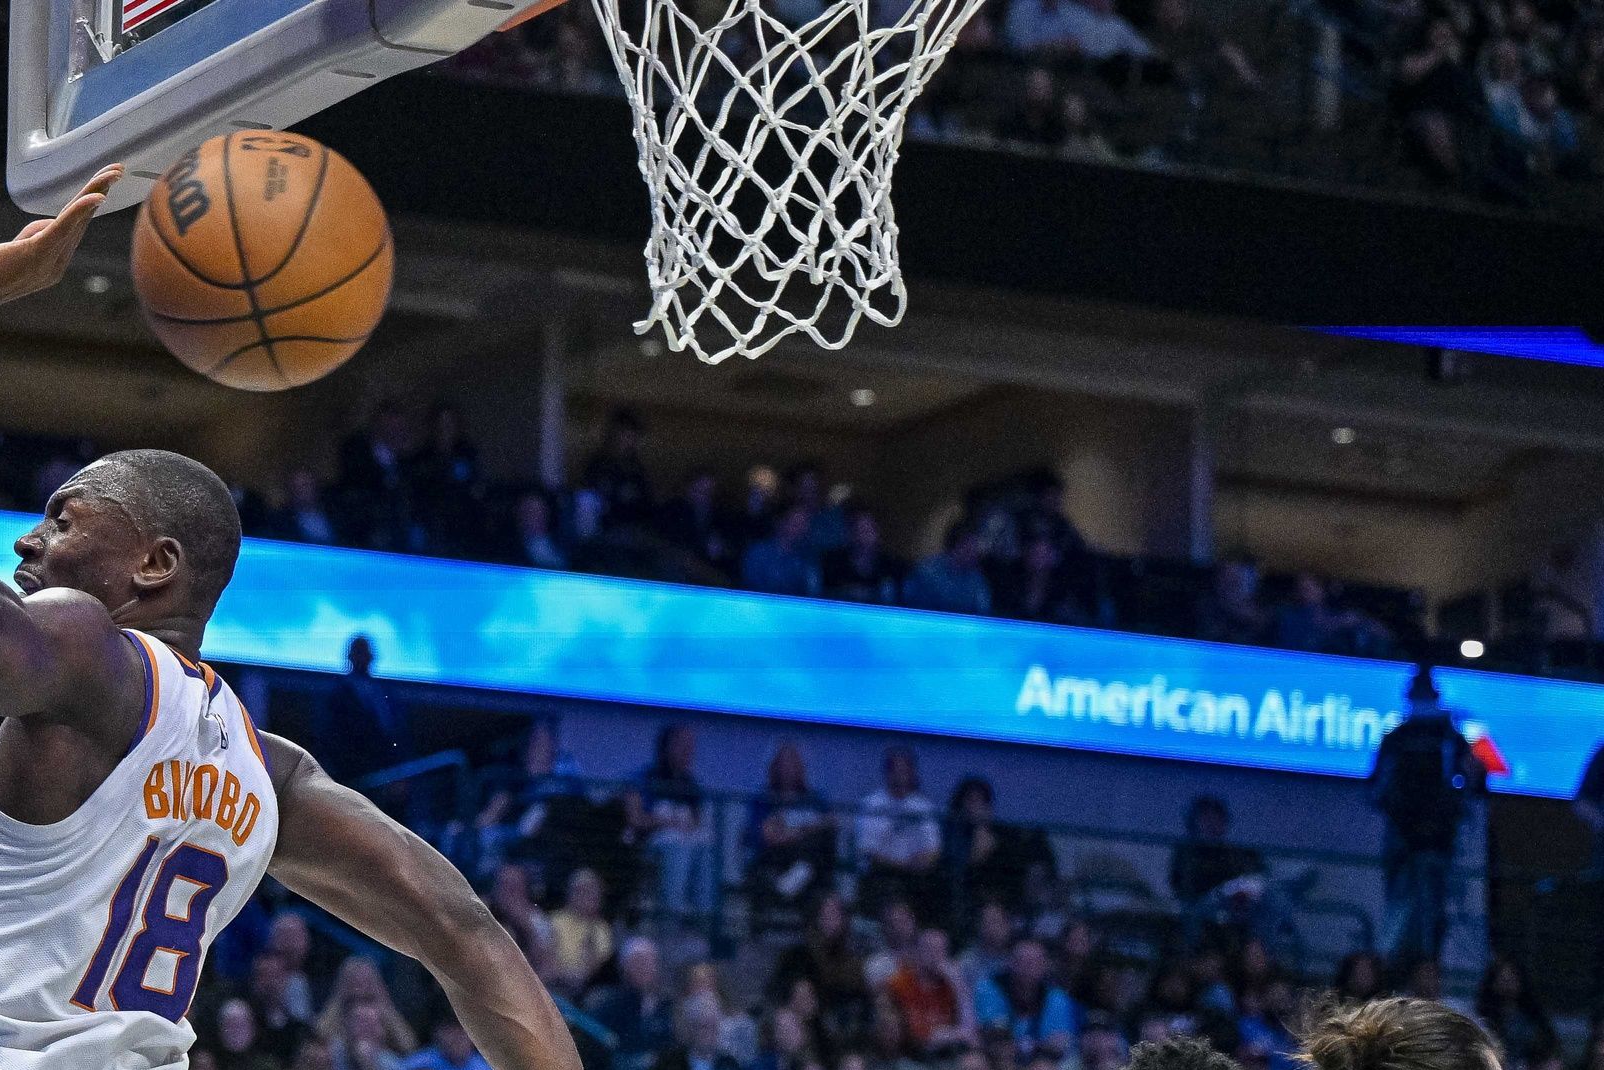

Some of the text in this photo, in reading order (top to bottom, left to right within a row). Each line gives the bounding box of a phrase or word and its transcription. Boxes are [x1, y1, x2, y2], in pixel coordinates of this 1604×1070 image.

[1016, 664, 1406, 751] American Airlin
[69, 835, 229, 1025] 18
